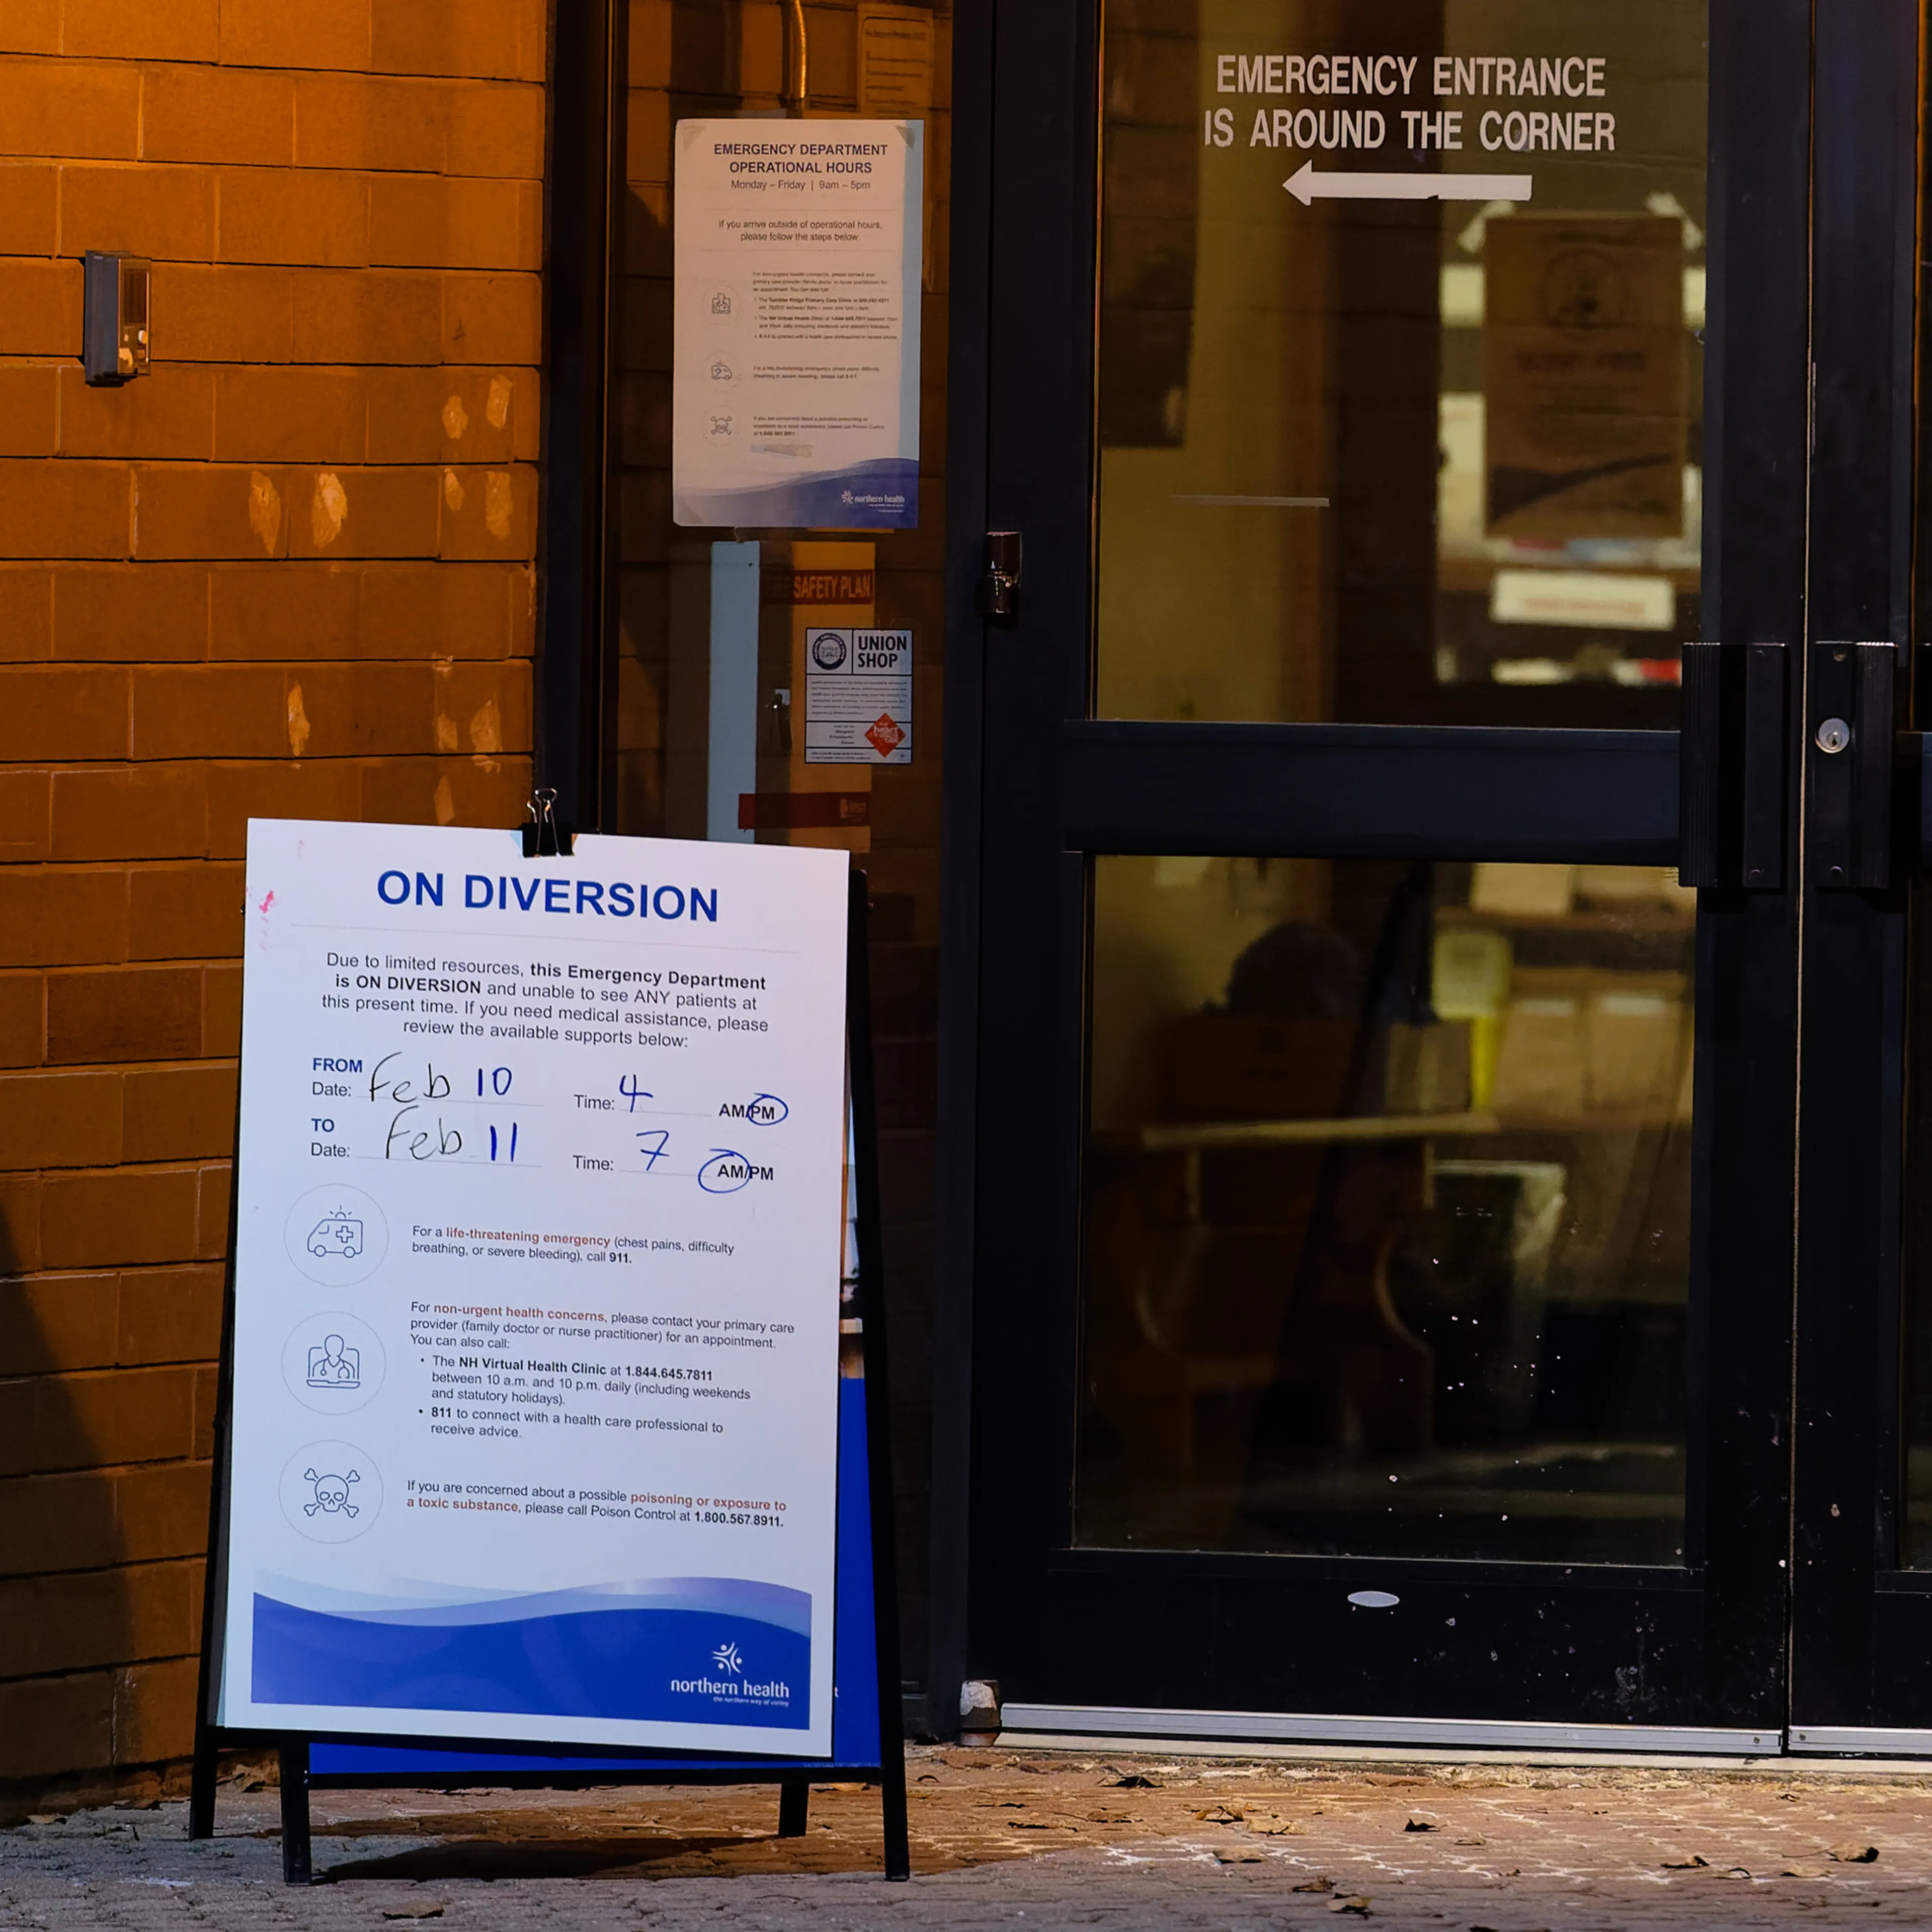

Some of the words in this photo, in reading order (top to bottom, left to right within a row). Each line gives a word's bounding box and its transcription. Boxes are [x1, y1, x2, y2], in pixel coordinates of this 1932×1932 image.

[1218, 54, 1417, 96] EMERGENCY
[1434, 57, 1605, 97] ENTRANCE
[1205, 108, 1234, 147] IS
[1250, 109, 1385, 149] AROUND
[1401, 111, 1463, 149] THE
[1480, 111, 1615, 151] CORNER
[714, 144, 796, 155] EMERGENCY
[800, 144, 888, 155] DEPARTMENT
[730, 162, 822, 173] OPERATIONAL
[827, 162, 871, 173] HOURS
[731, 180, 767, 191] Monday
[778, 179, 806, 191] Friday
[819, 180, 839, 189] 9am
[850, 180, 870, 191] 5pm
[719, 219, 725, 228] If
[727, 221, 741, 229] you
[768, 220, 798, 228] outside
[799, 220, 808, 228] of
[810, 220, 855, 229] operational
[741, 232, 768, 242] please
[769, 232, 793, 241] follow
[810, 233, 832, 242] steps
[854, 494, 883, 503] northern
[884, 494, 905, 503] health
[793, 576, 838, 599] SAFETY
[841, 574, 871, 598] PLAN
[858, 635, 907, 651] UNION
[858, 653, 898, 668] SHOP
[377, 870, 443, 906] ON
[465, 874, 717, 922] DIVERSION
[328, 952, 359, 967] Due
[365, 955, 379, 968] to
[386, 955, 435, 971] limited
[442, 961, 523, 977] resources,
[530, 963, 561, 977] this
[569, 965, 662, 987] Emergency
[669, 971, 765, 990] Department
[336, 974, 349, 988] is
[356, 975, 380, 989] ON
[388, 977, 480, 994] DIVERSION
[488, 983, 516, 996] and
[523, 985, 574, 999] unable
[581, 987, 594, 1000] to
[601, 991, 628, 1002] see
[634, 990, 670, 1004] ANY
[677, 993, 736, 1009] patients
[743, 997, 756, 1010] at
[323, 994, 349, 1009] this
[356, 999, 415, 1012] present
[421, 999, 457, 1014] time.
[465, 1001, 474, 1014] If
[480, 1005, 507, 1018] you
[514, 1005, 552, 1018] need
[559, 1007, 618, 1022] medical
[625, 1011, 711, 1030] assistance,
[718, 1016, 768, 1032] please
[404, 1019, 454, 1034] review
[460, 1021, 484, 1036] the
[490, 1024, 558, 1040] available
[565, 1030, 632, 1045] supports
[639, 1031, 687, 1047] below:
[313, 1058, 362, 1073] FROM
[369, 1051, 450, 1103] Feb
[477, 1067, 512, 1097] 10
[312, 1082, 351, 1096] Date:
[619, 1074, 654, 1113] 4
[574, 1094, 614, 1110] Time:
[718, 1103, 775, 1120] AM/PM
[311, 1118, 335, 1133] TO
[385, 1104, 462, 1160] Feb
[490, 1122, 517, 1162] 11
[311, 1143, 349, 1157] Date:
[636, 1130, 671, 1171] 7
[573, 1155, 613, 1171] Time:
[717, 1164, 774, 1181] AM/PM
[413, 1226, 432, 1237] For
[435, 1229, 442, 1237] a
[446, 1227, 539, 1245] life-threatening
[543, 1235, 610, 1249] emergency
[614, 1236, 648, 1249] (chest
[652, 1239, 684, 1252] pains,
[688, 1241, 734, 1256] difficulty
[413, 1242, 468, 1257] breathing,
[472, 1247, 484, 1255] or
[488, 1248, 525, 1257] severe
[529, 1248, 583, 1263] bleeding),
[587, 1251, 606, 1261] call
[609, 1252, 631, 1263] 911.
[411, 1301, 430, 1313] For
[434, 1305, 502, 1318] non-urgent
[506, 1307, 543, 1318] health
[547, 1311, 607, 1323] concerns,
[611, 1312, 649, 1325] please
[652, 1316, 693, 1327] contact
[696, 1319, 721, 1330] your
[724, 1320, 766, 1334] primary
[770, 1324, 794, 1333] care
[410, 1334, 432, 1345] You
[436, 1337, 456, 1346] can
[460, 1336, 484, 1348] also
[488, 1338, 509, 1348] call:
[433, 1355, 455, 1366] The
[459, 1357, 477, 1368] NH
[482, 1358, 523, 1370] Virtual
[528, 1360, 567, 1373] Health
[572, 1362, 606, 1375] Clinic
[610, 1366, 621, 1376] at
[626, 1366, 711, 1381] 1.844.645.7811
[431, 1406, 451, 1418] 811
[457, 1409, 468, 1419] to
[472, 1411, 520, 1422] connect
[524, 1411, 548, 1422] with
[553, 1415, 559, 1423] a
[565, 1413, 601, 1426] health
[605, 1418, 631, 1427] care
[636, 1418, 707, 1432] professional
[712, 1422, 723, 1433] to
[408, 1480, 415, 1491] If
[419, 1483, 439, 1494] you
[443, 1484, 462, 1493] are
[466, 1485, 528, 1496] concerned
[532, 1486, 565, 1498] about
[568, 1490, 575, 1498] a
[580, 1490, 627, 1501] possible
[631, 1492, 692, 1508] poisoning
[697, 1498, 709, 1506] or
[713, 1499, 770, 1510] exposure
[774, 1501, 786, 1511] to
[407, 1499, 414, 1507] a
[419, 1497, 449, 1508] toxic
[453, 1499, 521, 1513] substance,
[525, 1502, 564, 1514] please
[568, 1504, 587, 1515] call
[591, 1505, 630, 1517] Poison
[634, 1507, 676, 1520] Control
[679, 1511, 690, 1521] at
[695, 1511, 783, 1527] 1.800.567.8911.
[671, 1677, 738, 1695] northern
[744, 1679, 789, 1698] health
